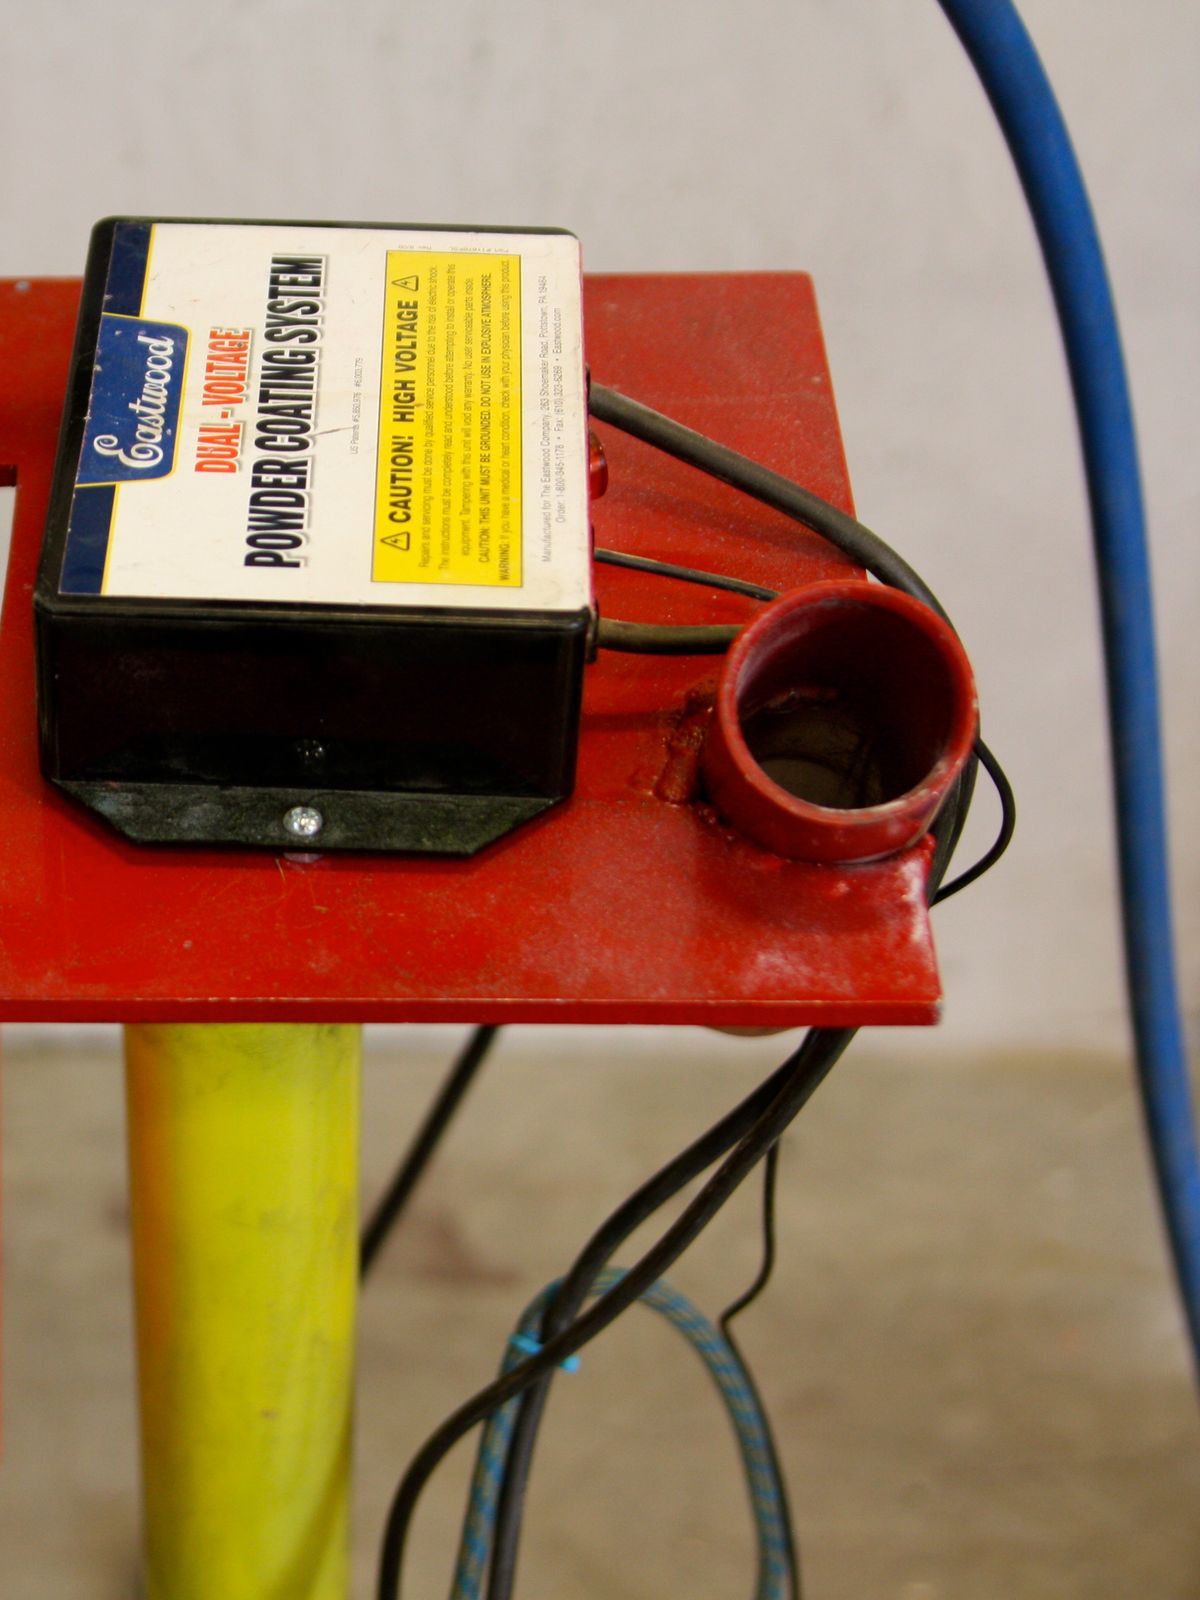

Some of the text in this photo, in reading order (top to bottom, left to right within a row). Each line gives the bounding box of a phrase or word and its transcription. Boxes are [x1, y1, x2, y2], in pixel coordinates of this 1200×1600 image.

[428, 267, 437, 283] shock.
[447, 264, 455, 274] this
[501, 260, 512, 282] product.
[447, 276, 457, 296] operate
[465, 278, 473, 295] inside.
[501, 284, 509, 293] this
[428, 285, 436, 305] electric
[481, 273, 492, 317] ATMOSPHERE.
[501, 295, 512, 310] using
[538, 295, 546, 303] PA
[465, 297, 475, 311] parts
[427, 313, 435, 323] risk
[446, 305, 455, 321] install
[500, 312, 510, 330] before
[427, 325, 435, 335] the
[464, 312, 473, 344] serviceable
[553, 308, 562, 353] Eastwood.com
[481, 320, 491, 354] EXPLOSIVE
[427, 344, 435, 354] due
[445, 331, 456, 362] attempting
[501, 332, 512, 359] physician
[202, 330, 251, 406] VOLTAGE
[426, 357, 436, 385] personnel
[463, 361, 472, 369] No
[481, 365, 491, 378] USE
[502, 361, 512, 374] your
[445, 364, 454, 383] before
[539, 360, 549, 396] Shoemaker
[463, 372, 474, 398] warranty.
[481, 381, 491, 394] NOT
[501, 377, 510, 388] with
[93, 336, 176, 469] Eastwood
[426, 388, 434, 409] service
[444, 384, 453, 419] understood
[464, 400, 474, 411] any
[481, 397, 490, 407] DO
[500, 390, 510, 408] check
[244, 257, 324, 568] POWDER COATING SYSTEM
[388, 301, 419, 523] CAUTION! HIGH VOLTAGE
[462, 414, 471, 425] void
[351, 425, 360, 444] Patents
[443, 422, 452, 433] and
[462, 428, 471, 437] will
[480, 409, 490, 450] GROUNDED.
[194, 423, 242, 473] DUAL
[350, 446, 358, 454] US
[423, 439, 434, 447] by
[442, 435, 452, 449] read
[461, 440, 471, 451] unit
[423, 449, 433, 465] done
[480, 454, 490, 462] BE
[500, 443, 510, 458] heart
[461, 454, 471, 464] this
[540, 449, 551, 482] Eastwood
[422, 467, 432, 475] be
[442, 451, 453, 486] completely
[460, 467, 470, 479] with
[480, 465, 490, 485] MUST
[423, 477, 431, 493] must
[500, 470, 510, 494] medical
[441, 488, 451, 496] be
[460, 482, 473, 515] Tampering
[480, 488, 490, 504] UNIT
[541, 484, 551, 497] The
[421, 496, 434, 525] servicing
[441, 499, 450, 514] must
[500, 504, 510, 519] have
[541, 500, 551, 510] for
[479, 507, 490, 523] THIS
[421, 527, 430, 540] and
[501, 521, 512, 533] you
[439, 518, 450, 555] instructions
[460, 520, 472, 556] equipment.
[541, 512, 552, 562] Manufactured
[479, 528, 490, 562] CAUTION:
[419, 542, 432, 567] Repairs
[499, 541, 510, 580] WARNING:
[439, 558, 449, 570] The
